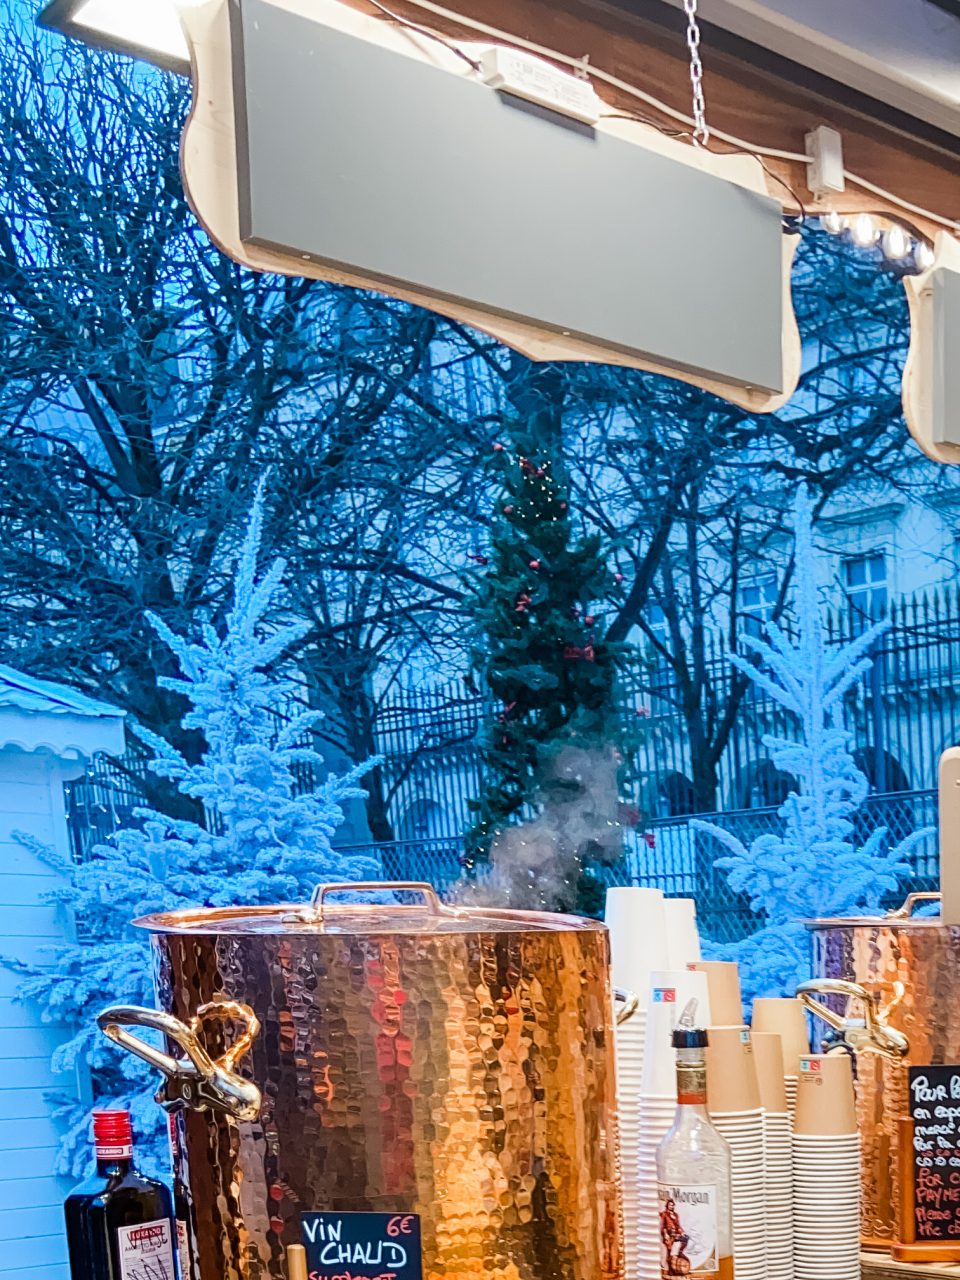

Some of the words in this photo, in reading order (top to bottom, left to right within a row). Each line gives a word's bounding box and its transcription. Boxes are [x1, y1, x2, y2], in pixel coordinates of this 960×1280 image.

[672, 1187, 710, 1206] Morgan
[386, 1215, 415, 1237] 6€
[320, 1240, 407, 1268] CHAUD
